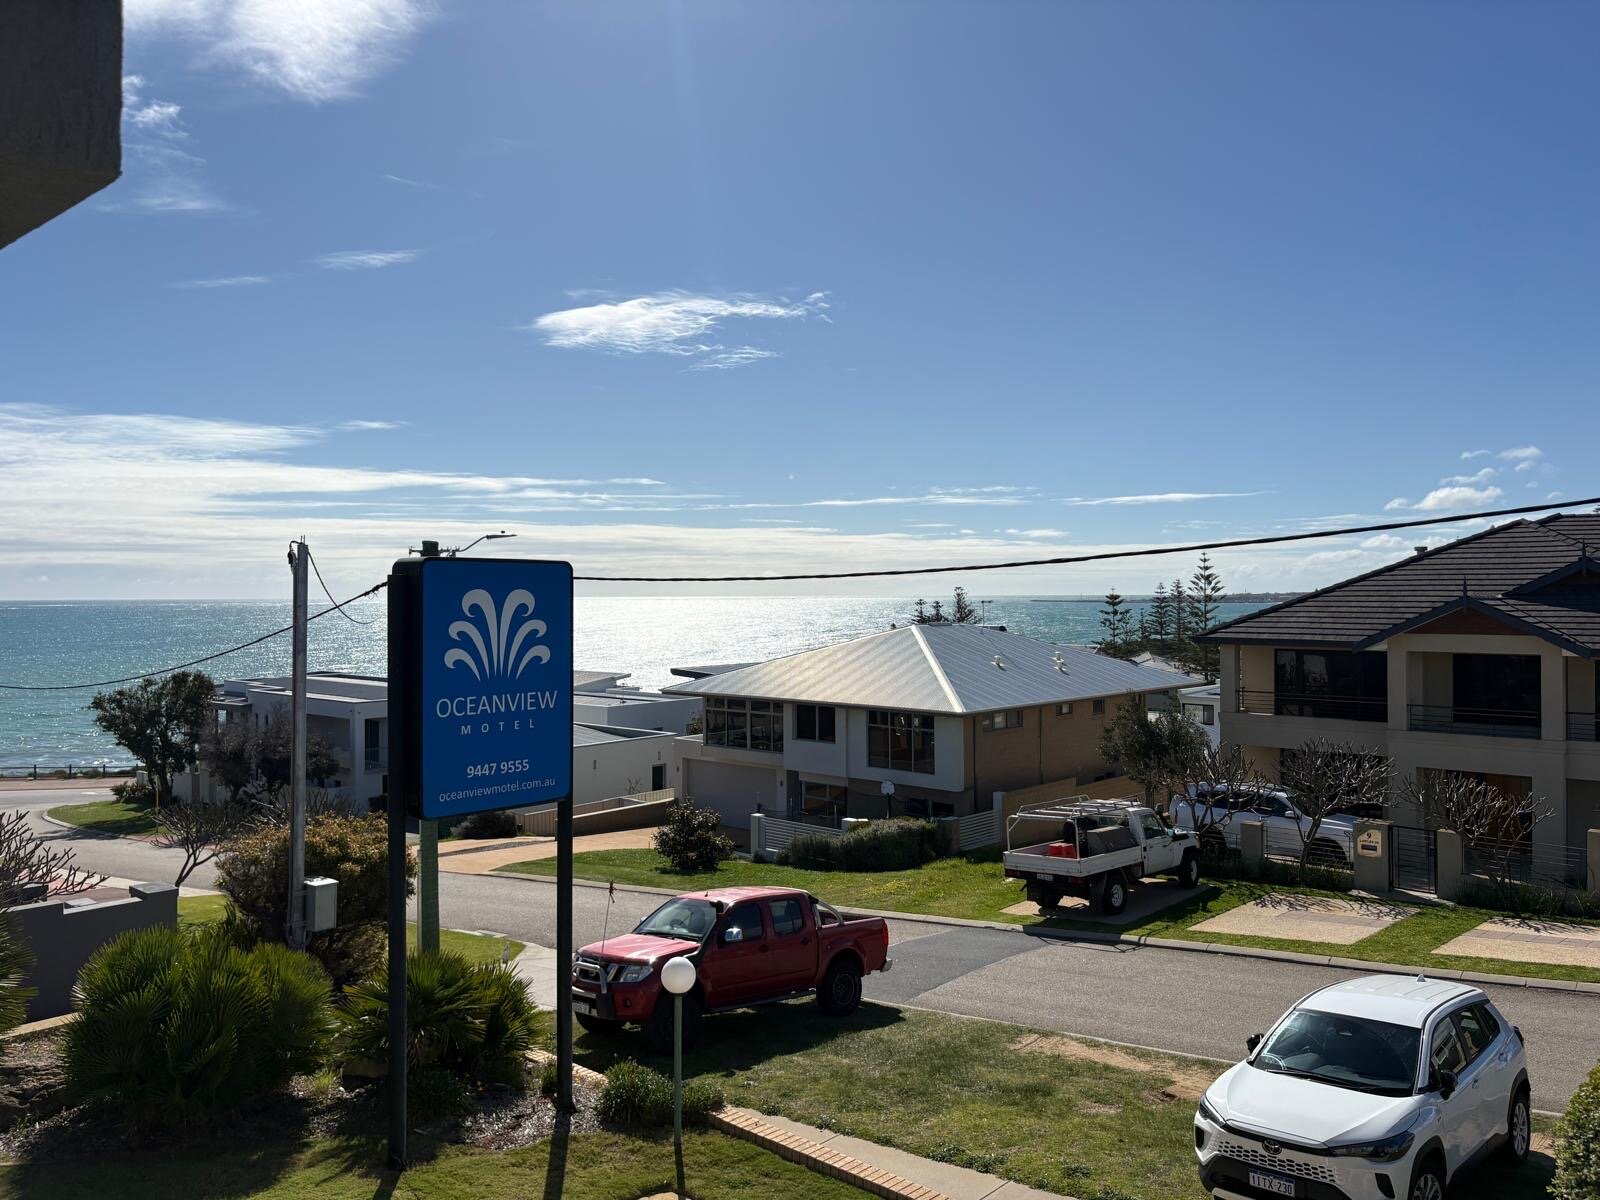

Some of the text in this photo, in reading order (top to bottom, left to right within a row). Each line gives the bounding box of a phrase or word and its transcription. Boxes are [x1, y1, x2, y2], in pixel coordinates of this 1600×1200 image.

[436, 690, 558, 718] OCEANVIEW
[461, 719, 534, 735] MOTEL
[466, 759, 530, 778] 9447 9555
[439, 778, 556, 802] oceanviewmotel.com.au
